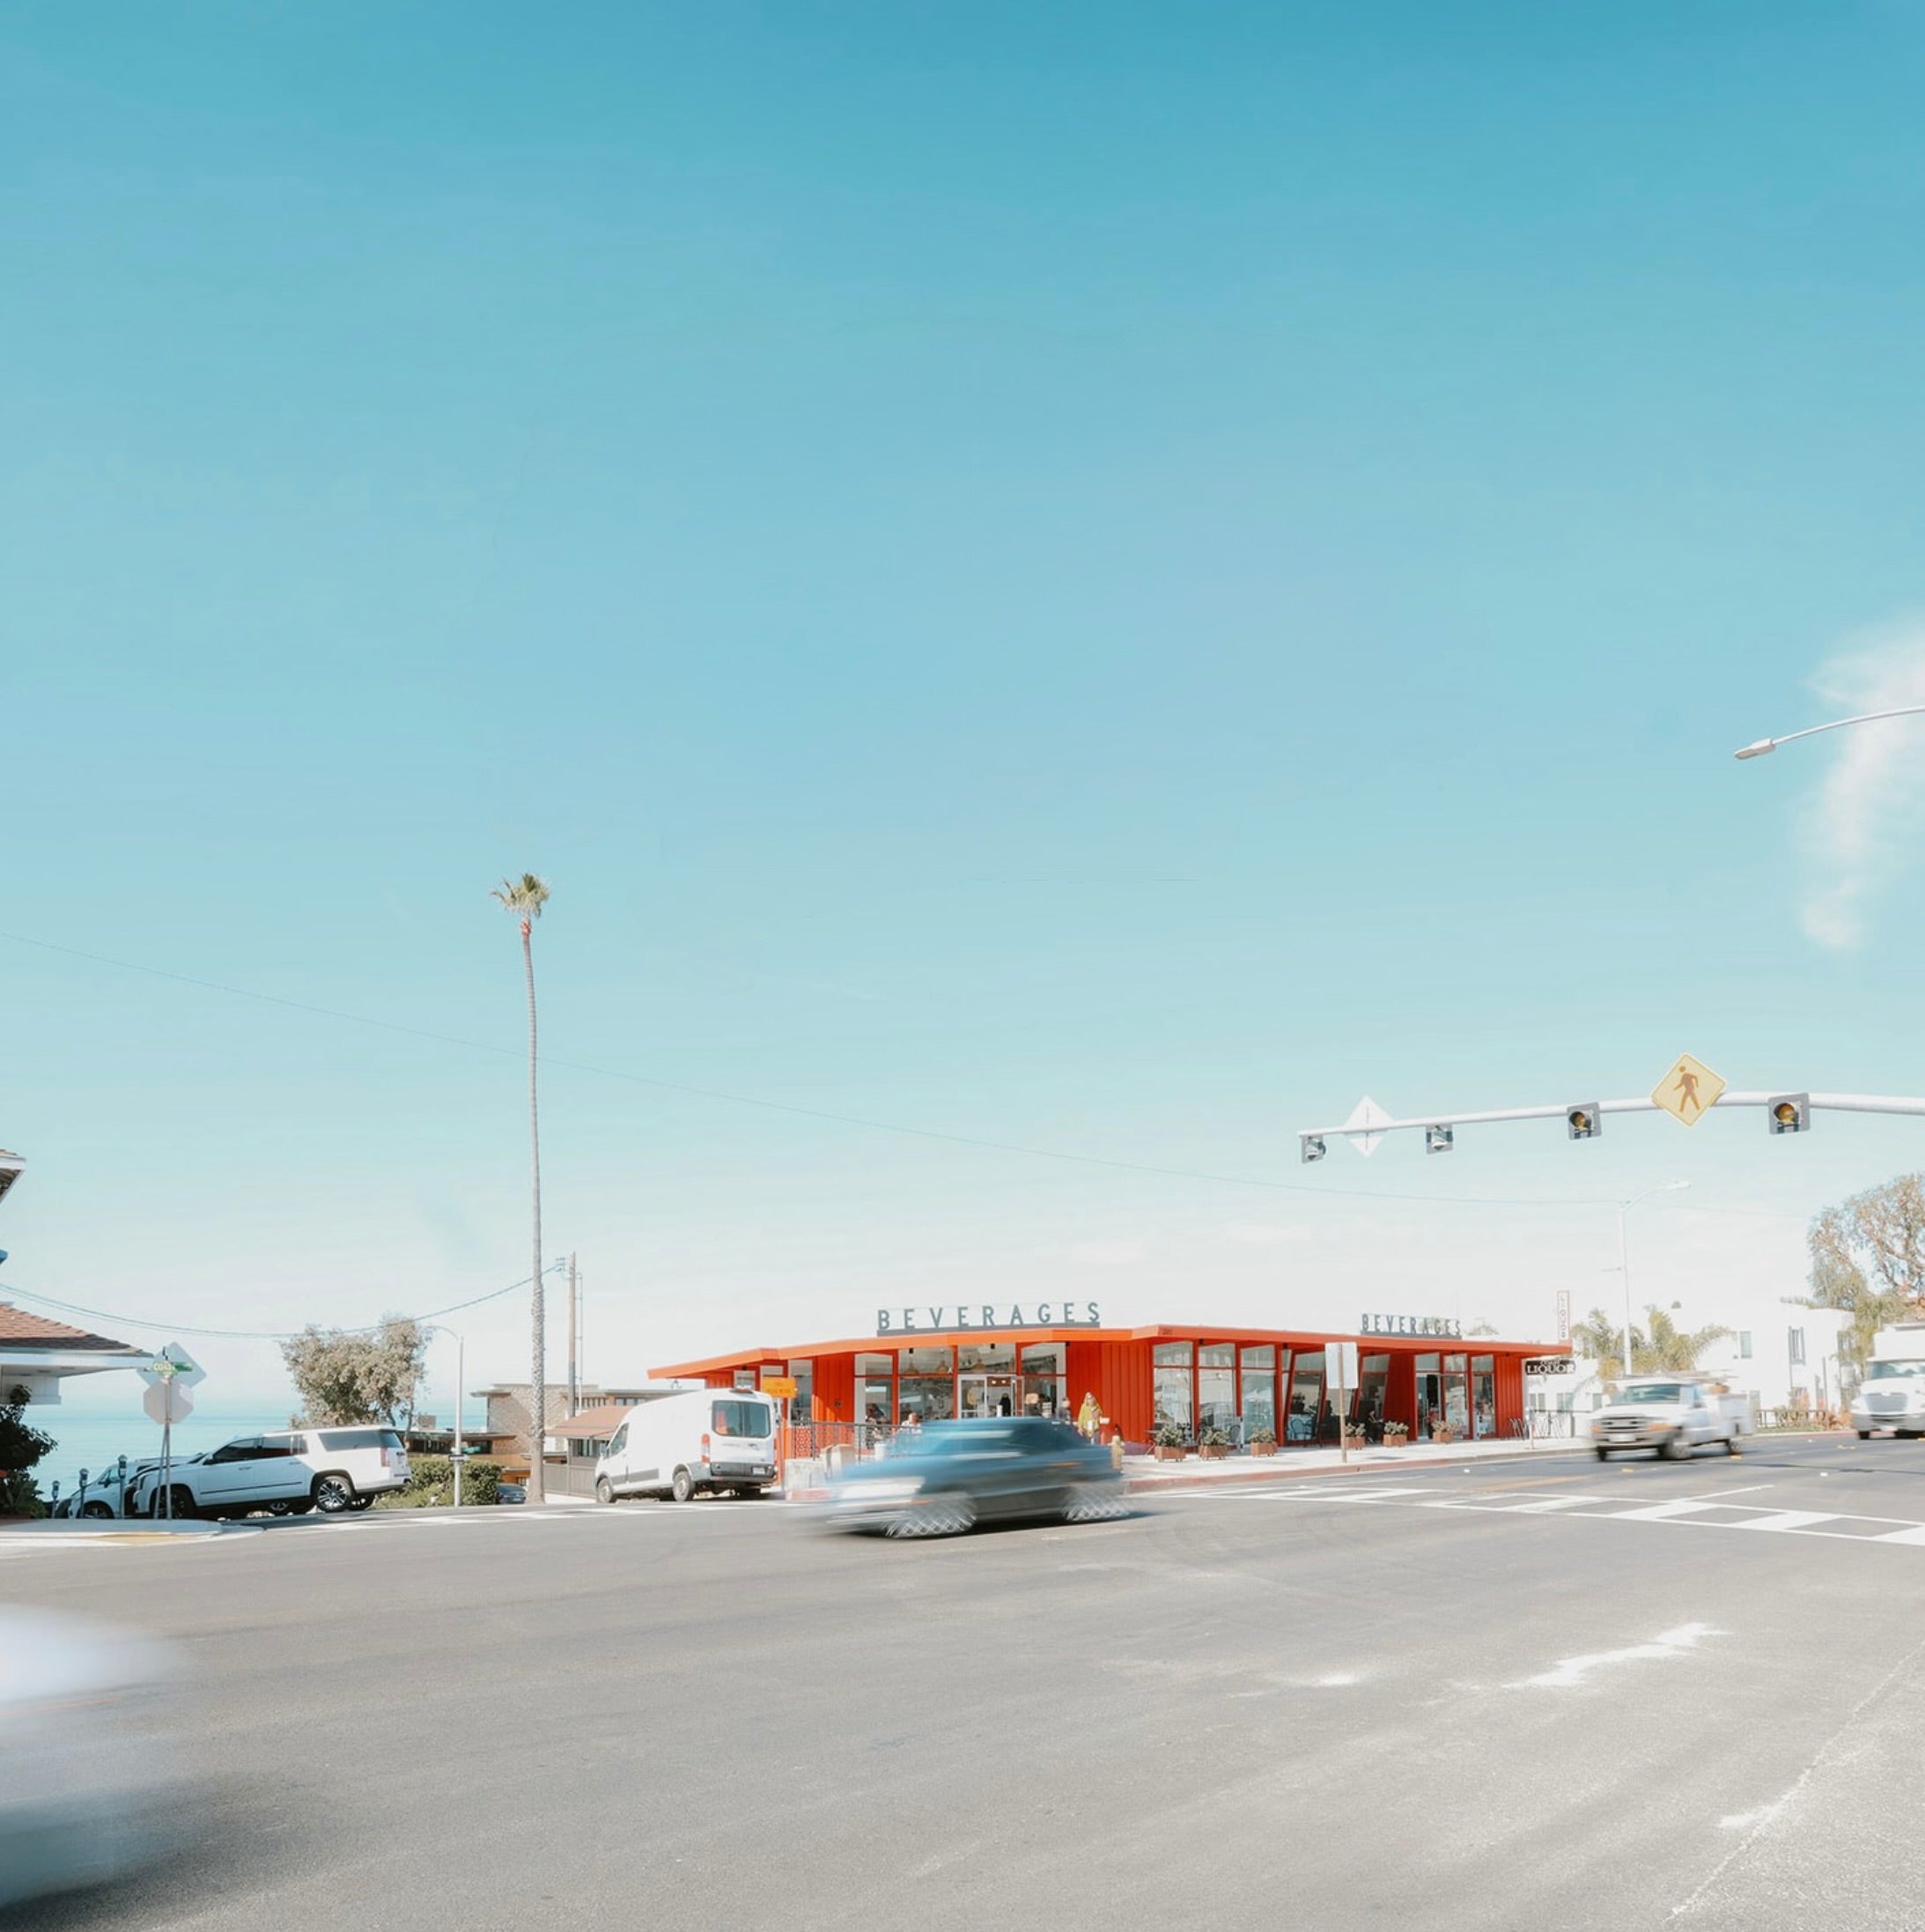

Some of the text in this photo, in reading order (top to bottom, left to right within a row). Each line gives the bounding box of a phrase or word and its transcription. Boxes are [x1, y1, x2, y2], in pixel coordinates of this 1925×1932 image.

[878, 1302, 1100, 1330] BEVERAGES
[1361, 1313, 1460, 1335] BEVERAGES
[1527, 1365, 1575, 1374] LIQUOR
